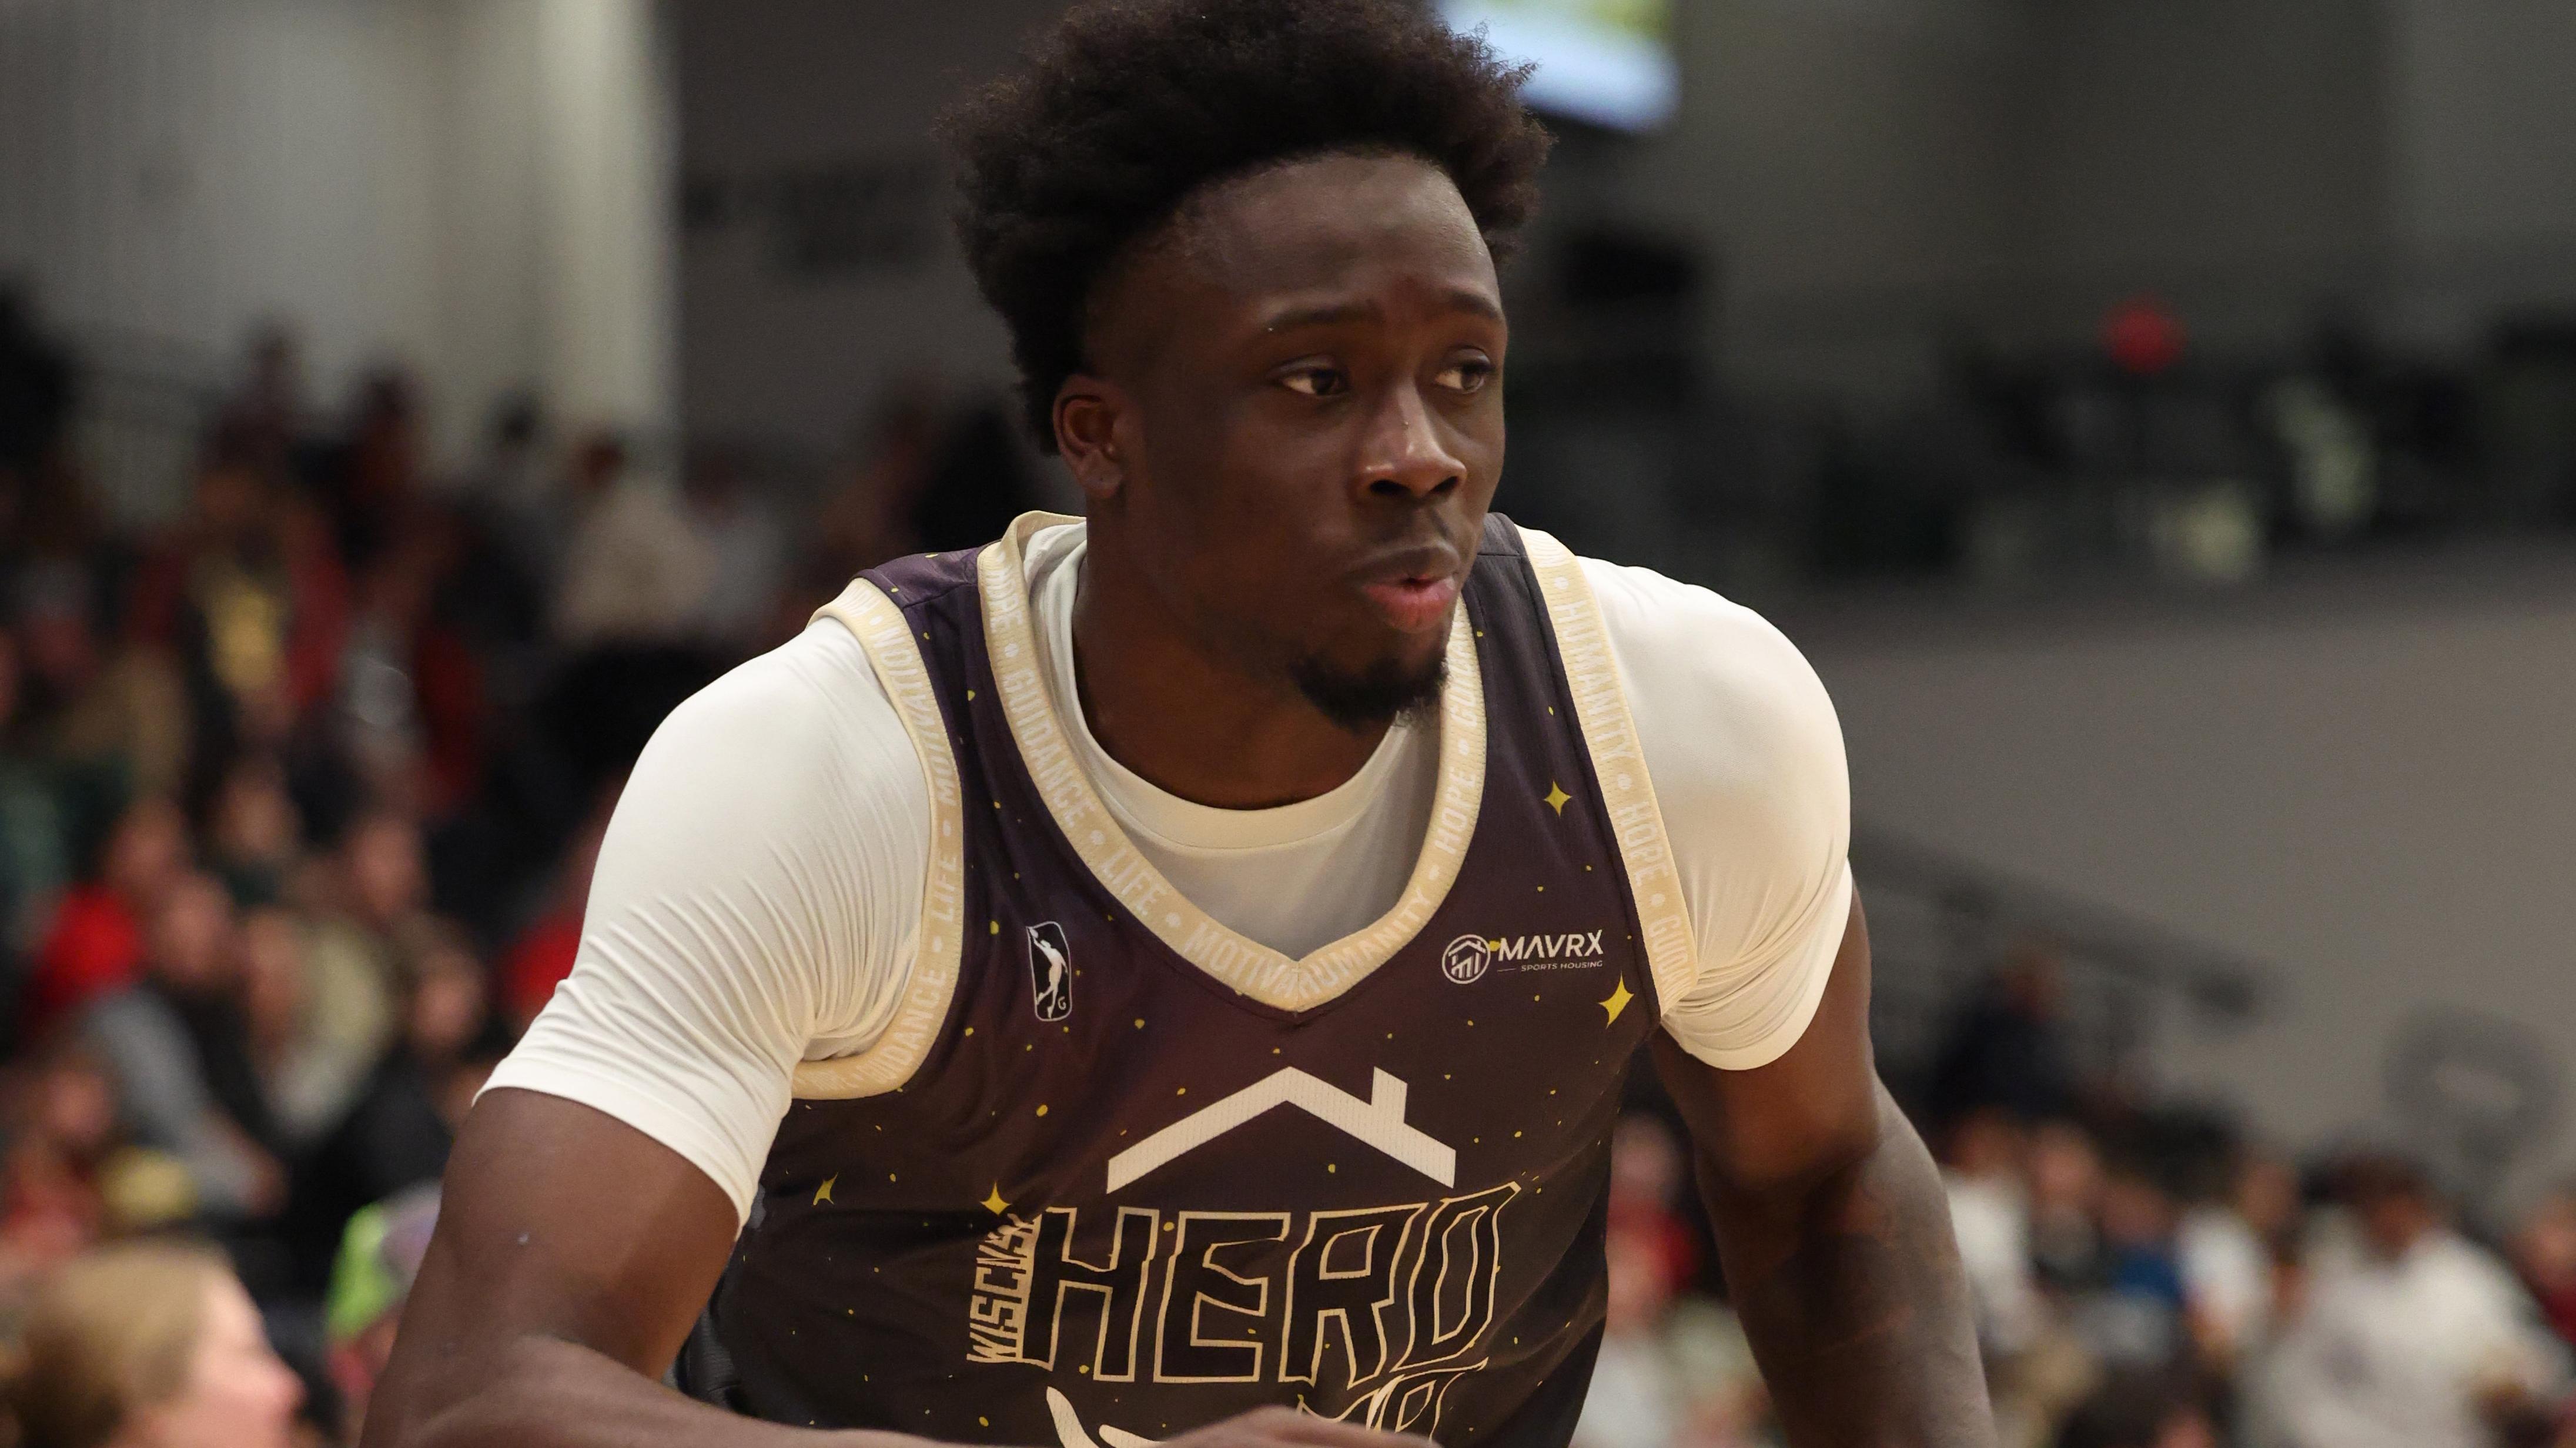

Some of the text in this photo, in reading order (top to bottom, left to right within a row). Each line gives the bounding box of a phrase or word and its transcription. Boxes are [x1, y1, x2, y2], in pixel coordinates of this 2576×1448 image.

[1554, 600, 1634, 761] HUMANITY
[1617, 801, 1668, 887] HOPE
[1005, 668, 1096, 828] GUIDANCE
[1100, 851, 1167, 916] LIFE
[1434, 768, 1477, 855] HOPE
[932, 855, 956, 922] LIFE
[1498, 929, 1604, 962] MAVRX
[1521, 959, 1604, 972] SPORTS HOUSING
